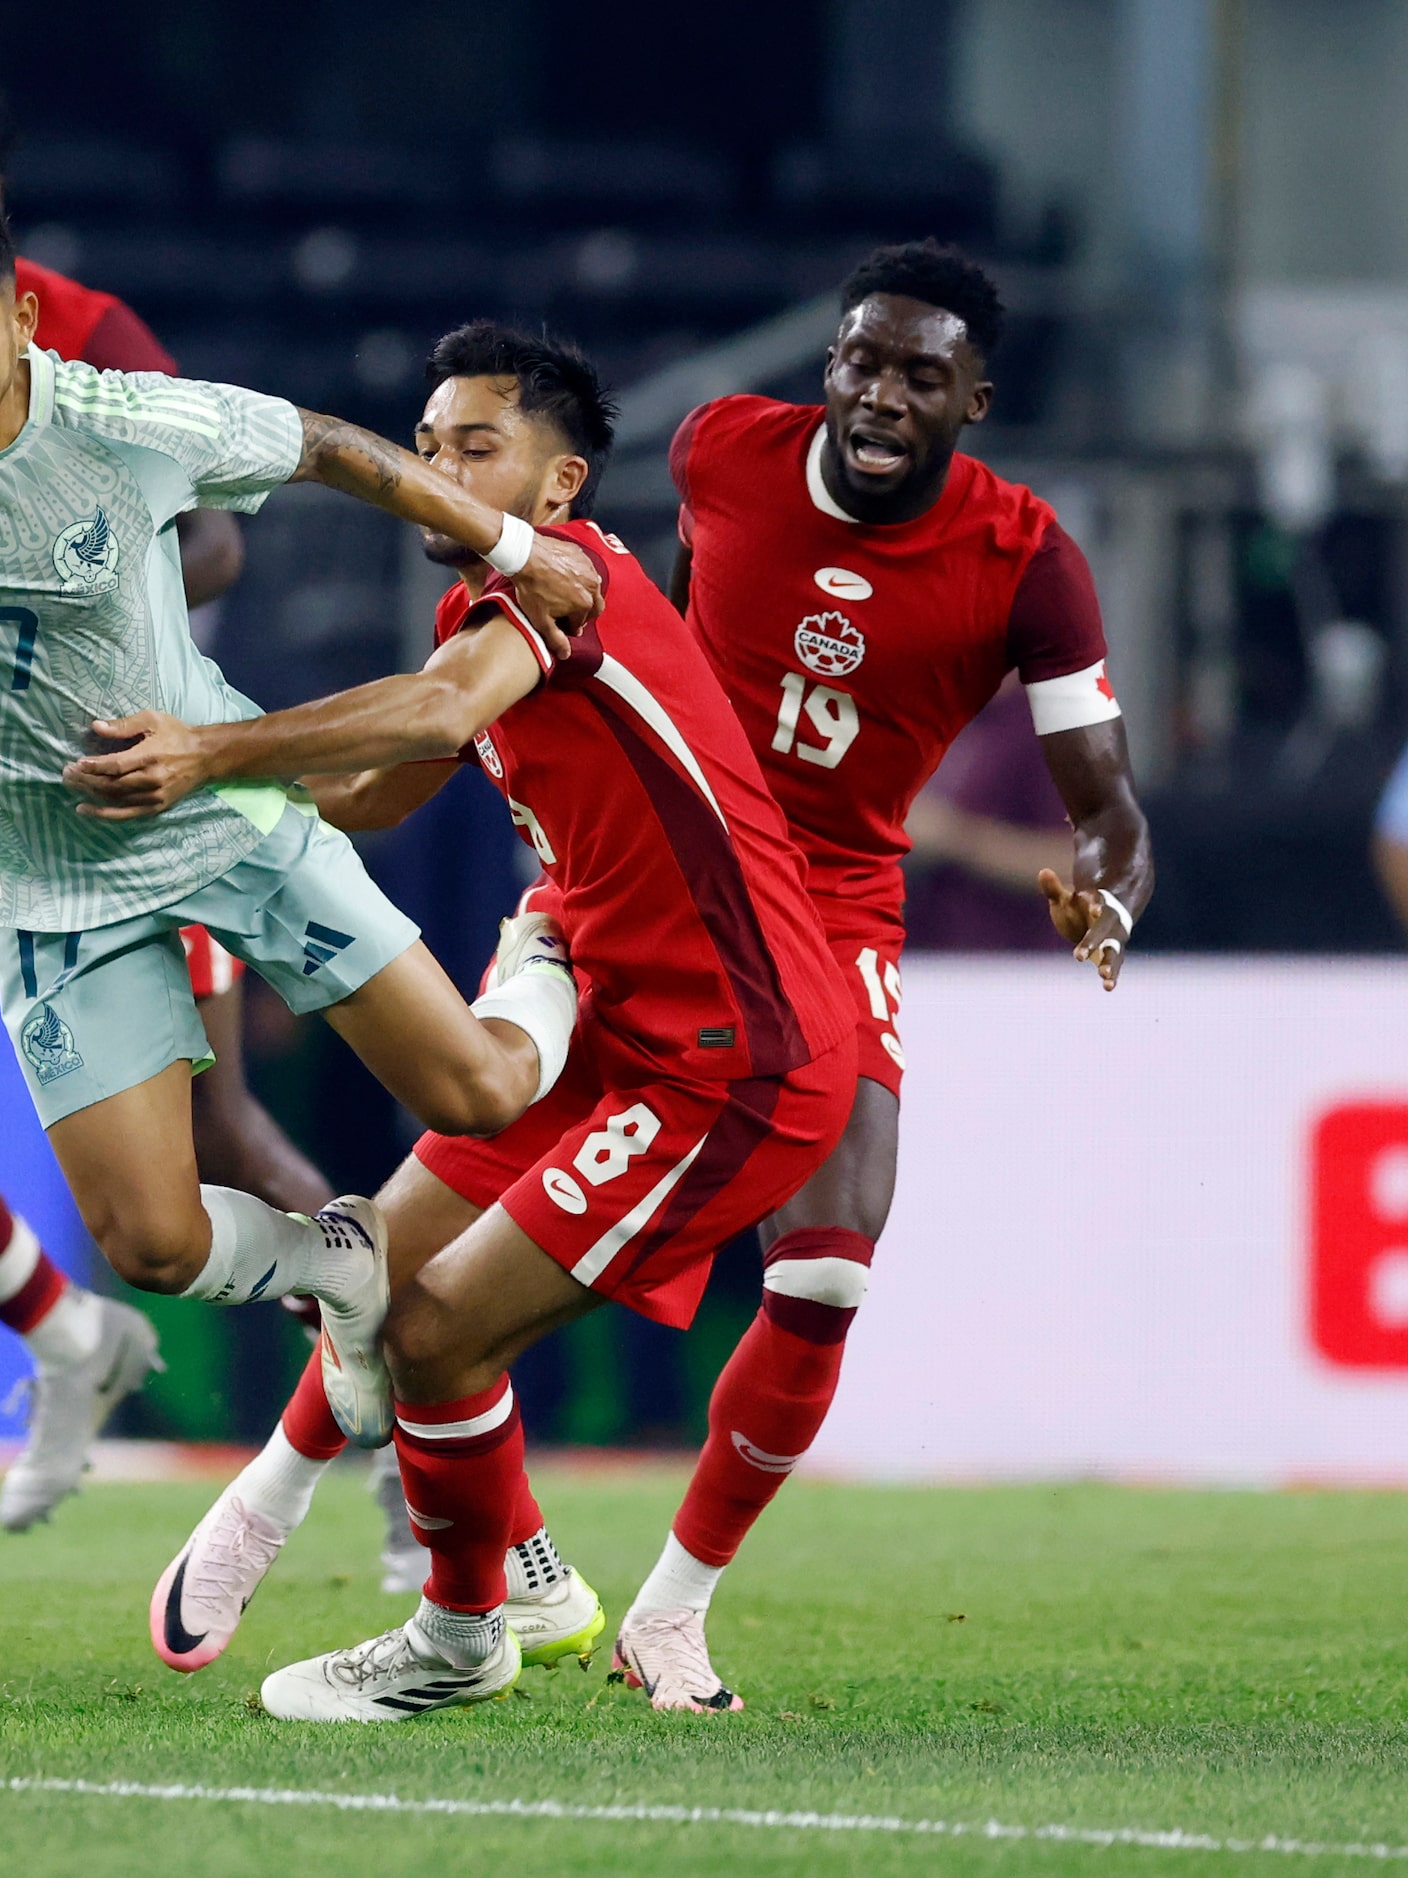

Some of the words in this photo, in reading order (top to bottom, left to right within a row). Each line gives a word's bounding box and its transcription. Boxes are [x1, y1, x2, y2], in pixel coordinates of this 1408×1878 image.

[798, 631, 861, 659] CANADA
[771, 671, 861, 769] 19
[572, 1102, 662, 1187] 8
[521, 1623, 547, 1632] COPA
